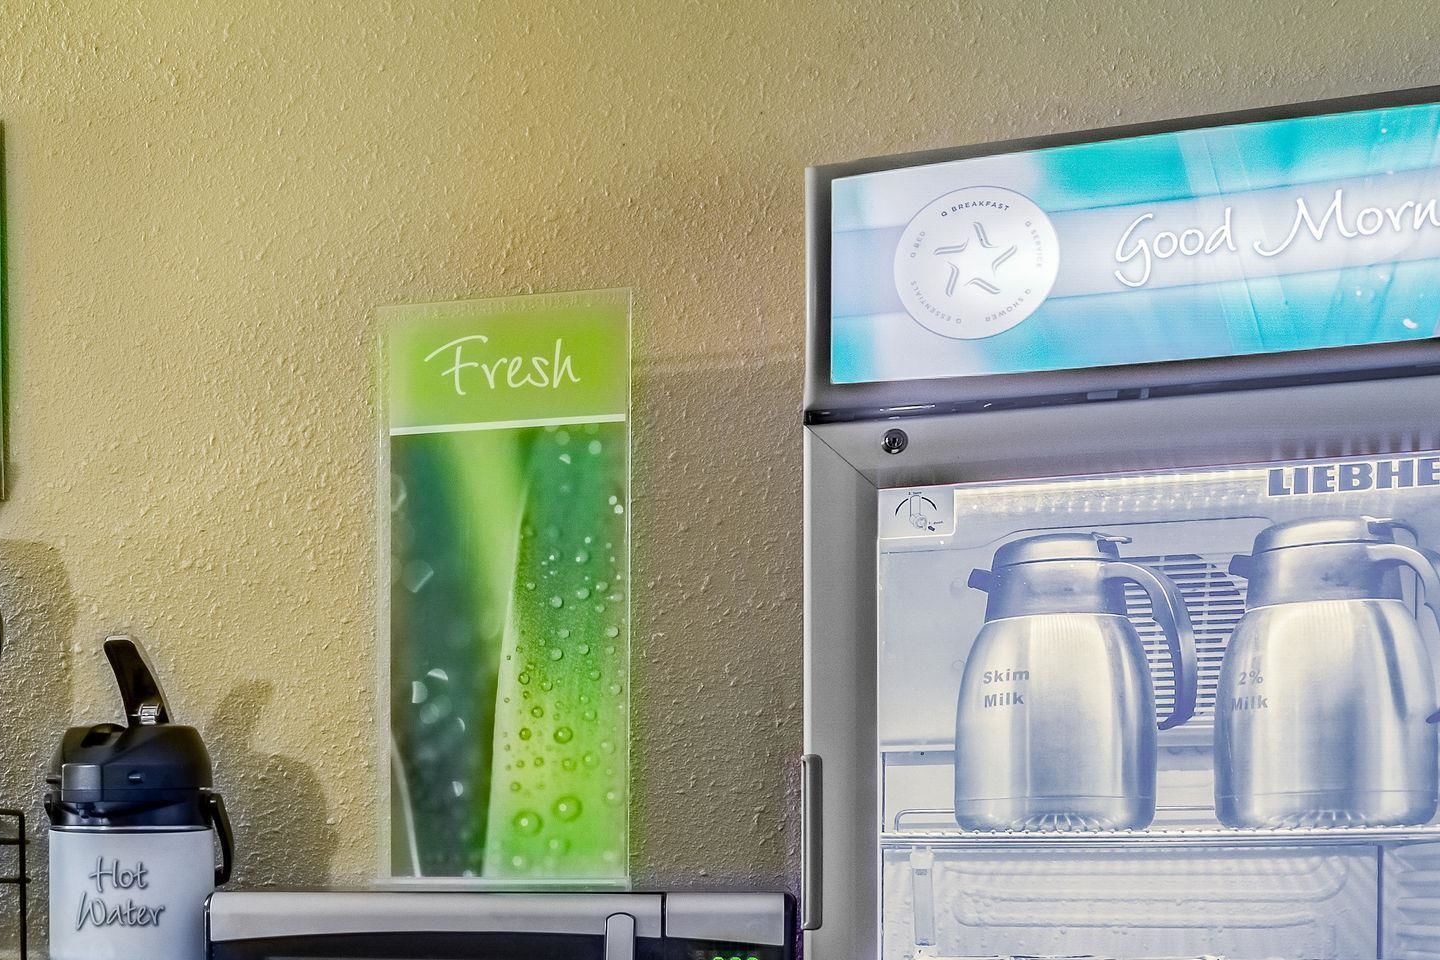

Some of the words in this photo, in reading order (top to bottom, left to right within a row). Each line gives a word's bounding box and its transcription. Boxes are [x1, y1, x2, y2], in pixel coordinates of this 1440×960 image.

[951, 200, 1010, 212] BREAKFAST
[1114, 206, 1237, 288] Good
[910, 280, 951, 322] ESSENTIALS
[985, 297, 1024, 322] SHOWER
[424, 334, 581, 395] Fresh
[983, 668, 1030, 684] Skim
[1238, 670, 1264, 686] 2%
[984, 692, 1025, 708] Milk
[1231, 695, 1269, 711] Milk
[88, 856, 149, 893] Hot
[76, 891, 166, 931] Water
